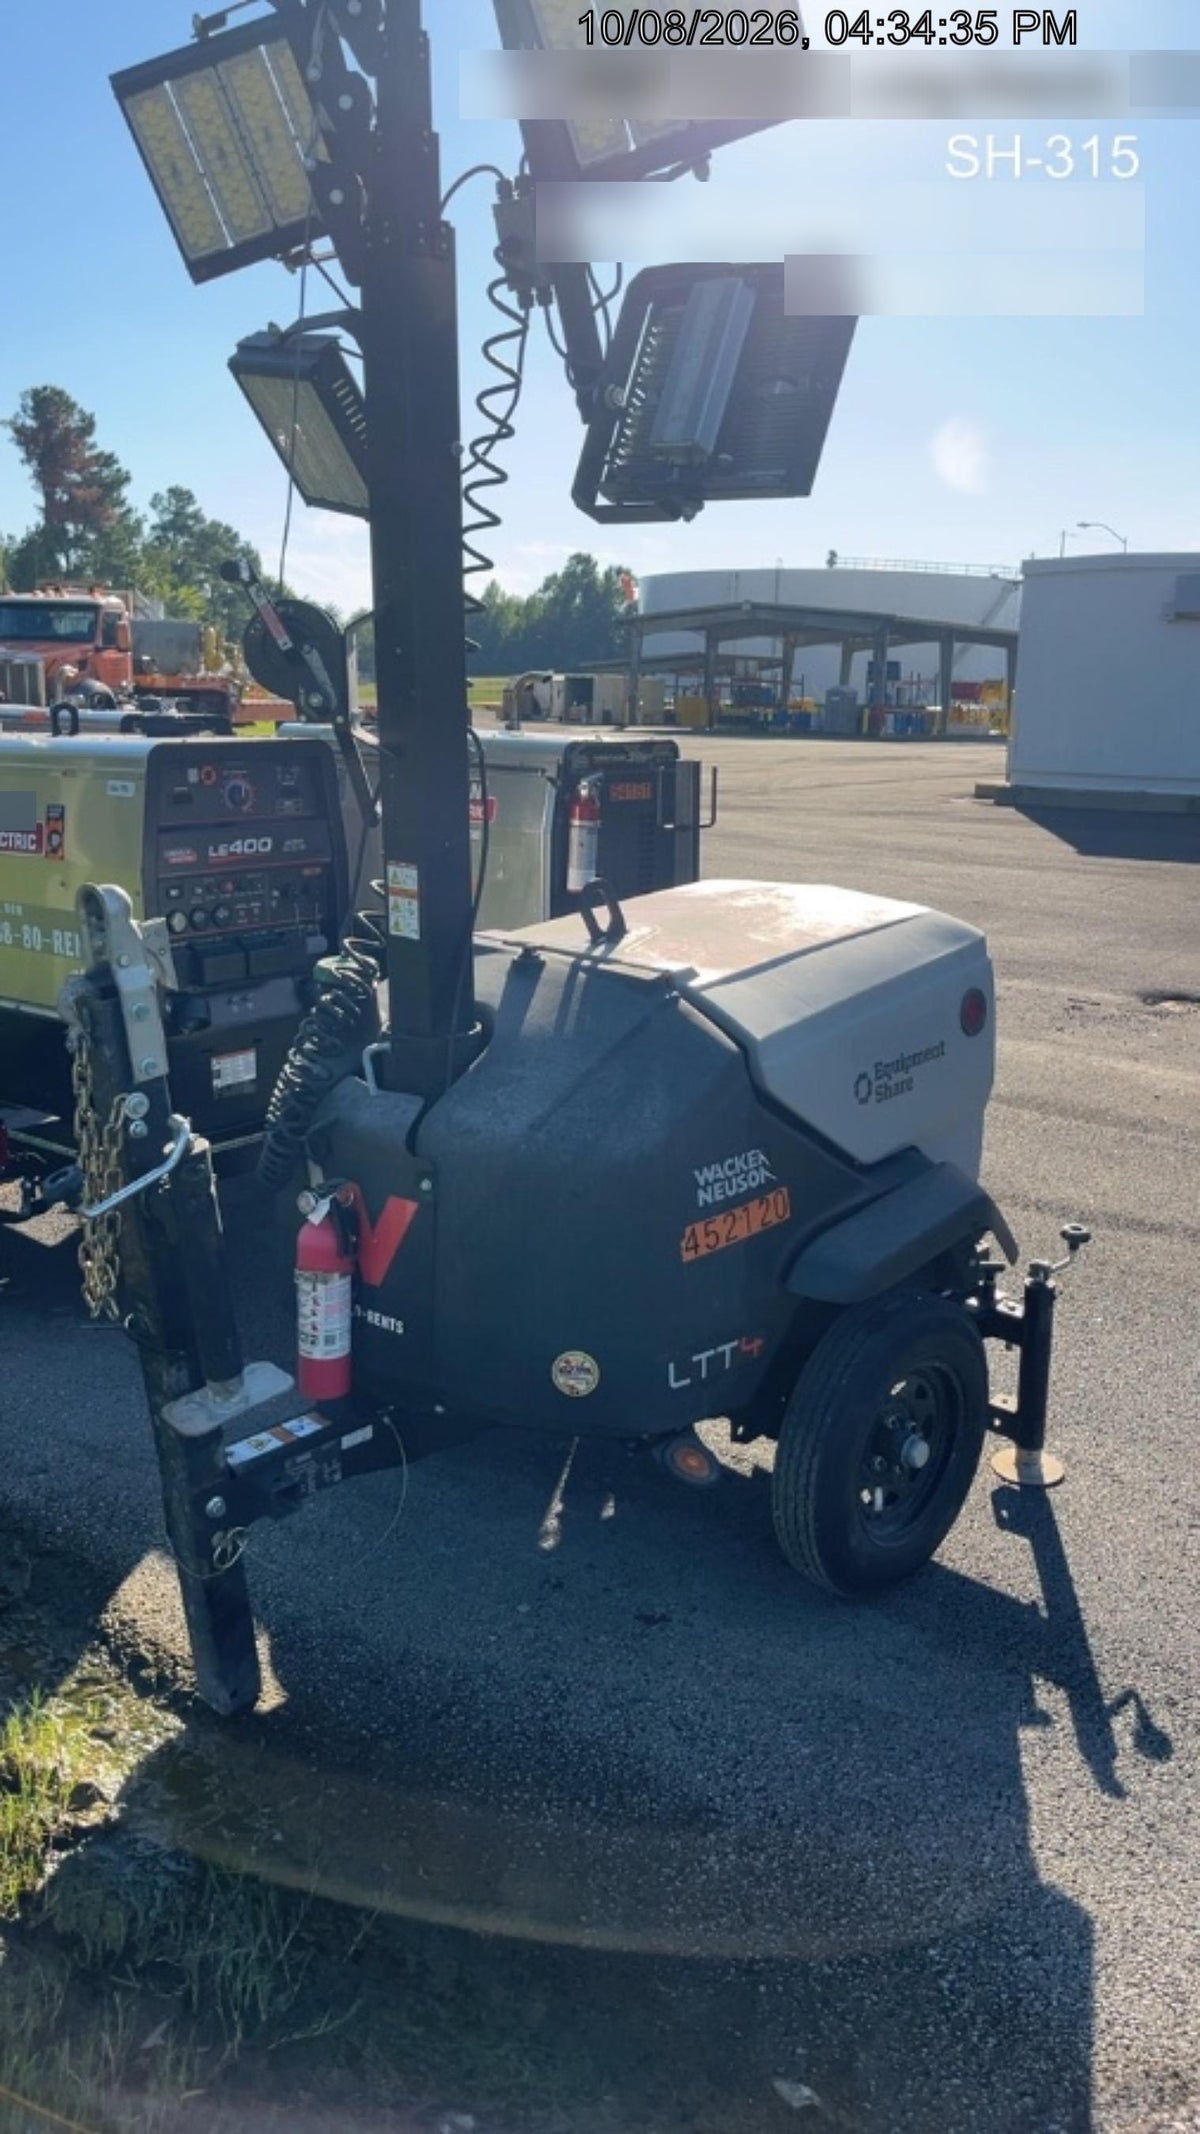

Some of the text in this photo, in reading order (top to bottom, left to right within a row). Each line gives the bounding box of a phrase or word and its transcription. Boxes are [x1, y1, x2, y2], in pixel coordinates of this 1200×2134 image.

[873, 1040, 946, 1081] Equipment
[874, 1076, 915, 1104] Share
[693, 1149, 771, 1186] WACKER
[697, 1166, 778, 1208] NEUSON
[684, 1189, 788, 1256] 452120
